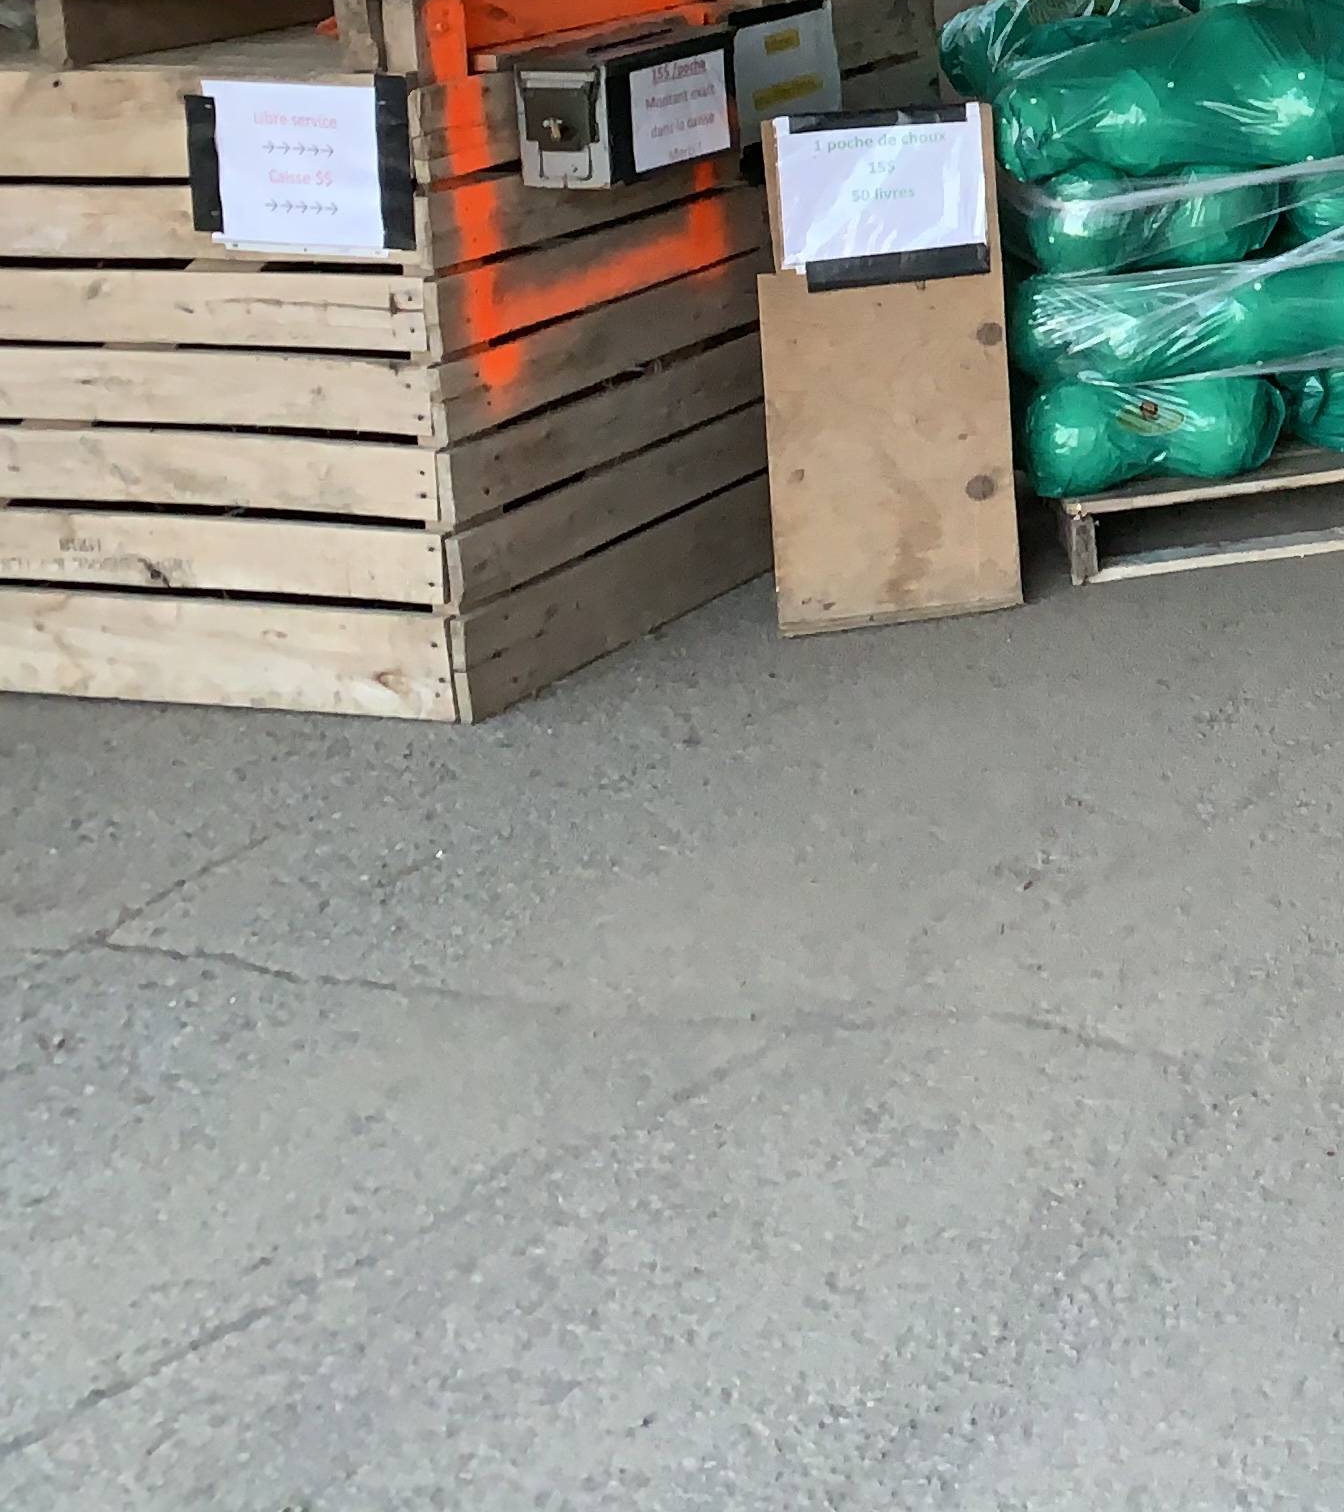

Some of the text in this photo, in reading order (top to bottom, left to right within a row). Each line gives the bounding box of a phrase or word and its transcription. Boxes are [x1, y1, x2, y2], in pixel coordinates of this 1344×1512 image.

[253, 111, 338, 129] Libre service
[814, 130, 946, 153] 1 poche de choux
[868, 161, 896, 175] 15$
[269, 169, 333, 187] Caisse $$
[851, 186, 915, 203] 50 livres
